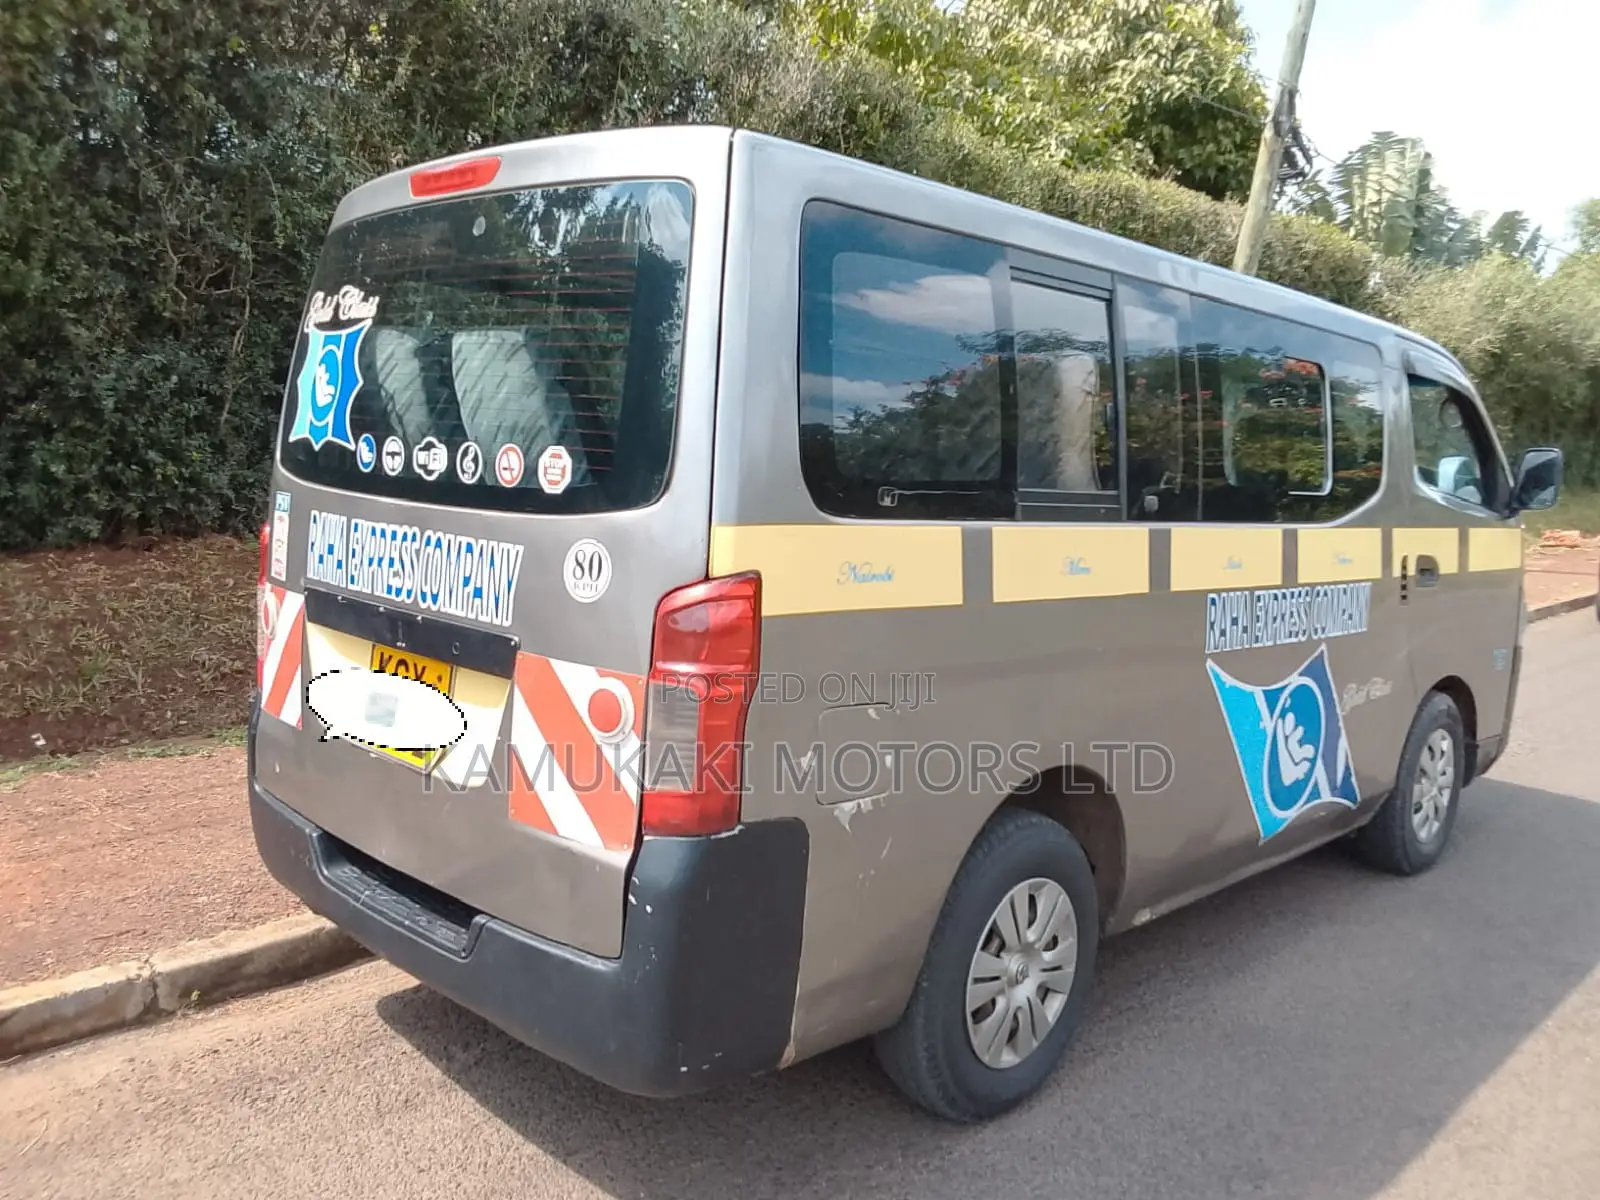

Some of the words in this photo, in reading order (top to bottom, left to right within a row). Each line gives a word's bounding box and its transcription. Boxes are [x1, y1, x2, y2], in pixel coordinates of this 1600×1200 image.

[306, 509, 348, 588] RAHA
[347, 518, 421, 604] EXPRESS
[417, 529, 525, 628] COMPANY
[572, 549, 603, 583] 80
[1205, 591, 1251, 654] RAHA
[1252, 586, 1311, 648] EXPRESS
[1310, 582, 1373, 640] COMPANY
